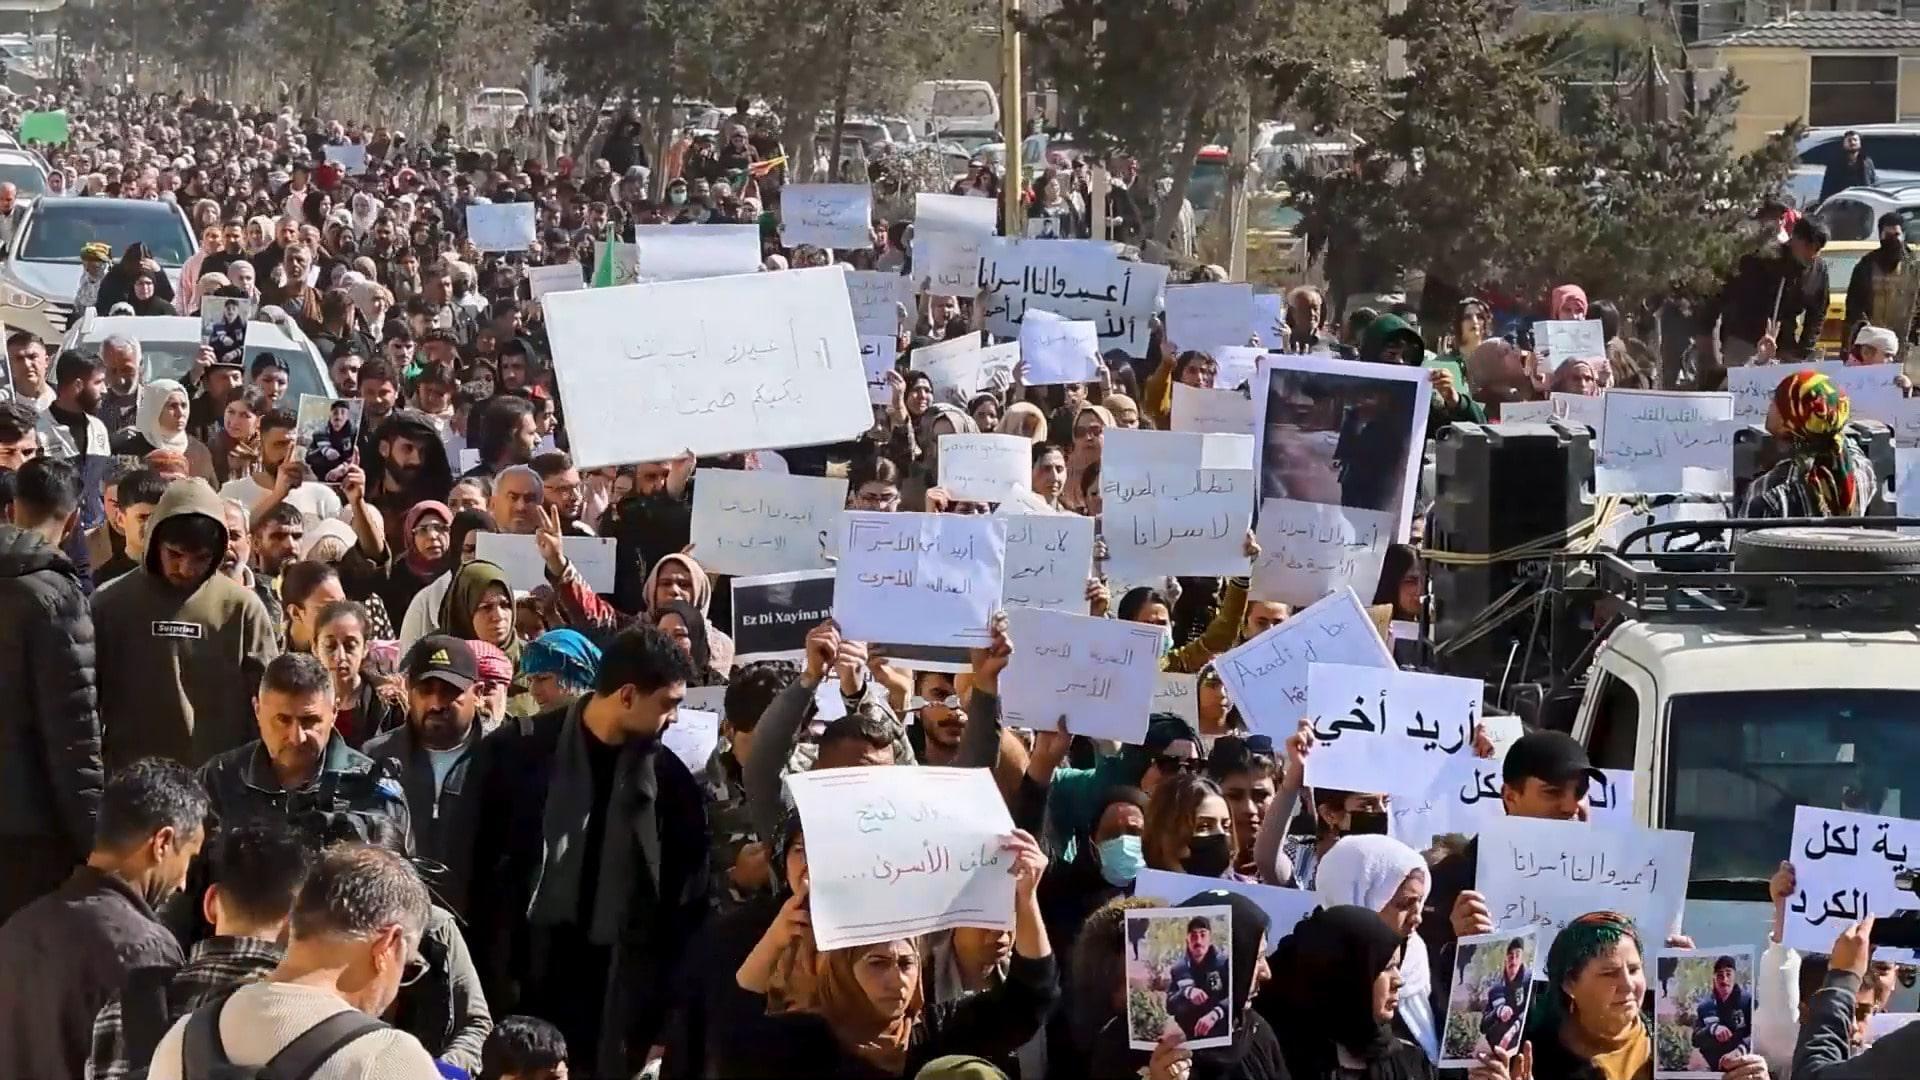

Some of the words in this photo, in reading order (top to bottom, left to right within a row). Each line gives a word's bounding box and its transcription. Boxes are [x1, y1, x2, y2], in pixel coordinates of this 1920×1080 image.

[158, 624, 195, 634] Surprise
[742, 615, 757, 626] Ez
[760, 611, 773, 625] Di
[1313, 689, 1387, 747] أخي
[1406, 700, 1476, 754] أريد
[1804, 820, 1860, 861] لكل
[1790, 887, 1868, 926] الكرد
